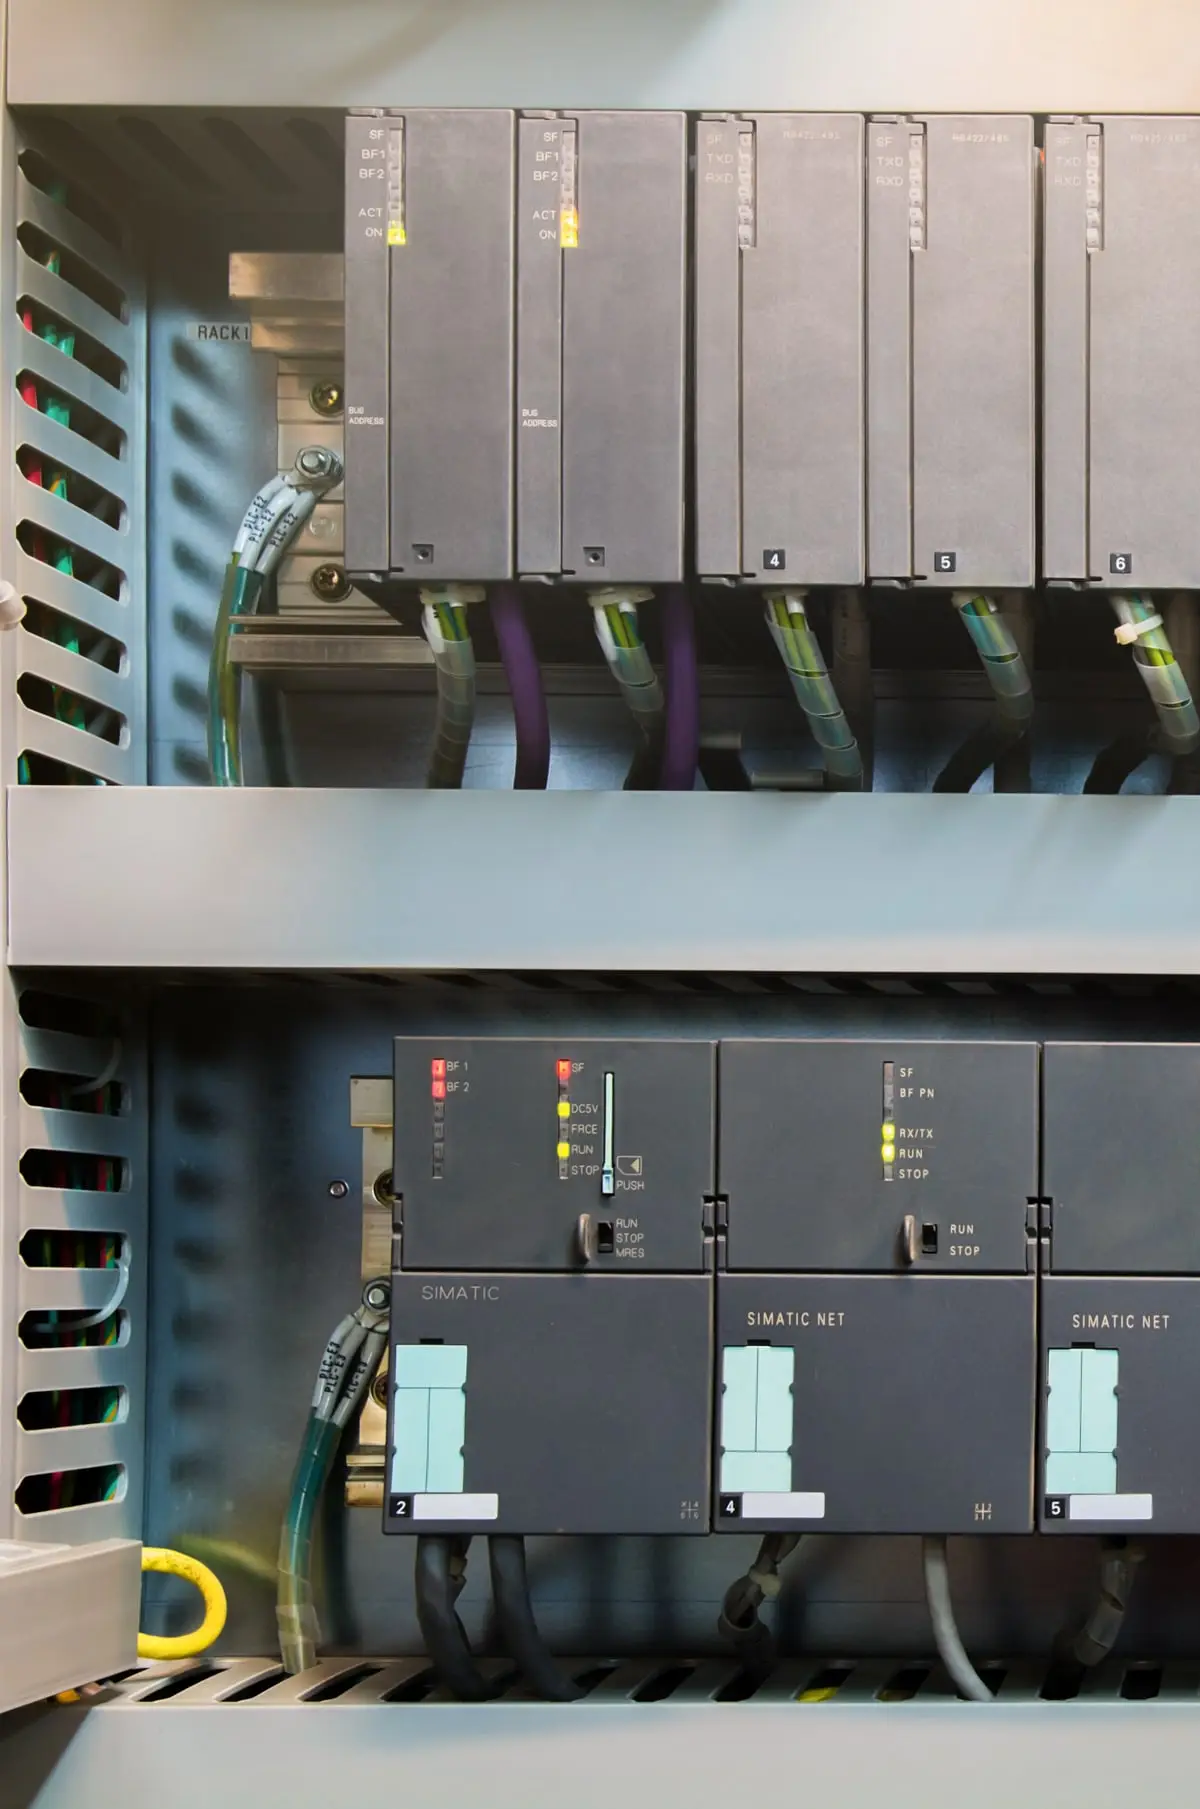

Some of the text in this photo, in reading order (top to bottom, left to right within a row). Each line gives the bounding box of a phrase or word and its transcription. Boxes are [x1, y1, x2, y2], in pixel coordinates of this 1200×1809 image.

[369, 129, 385, 140] SF
[543, 132, 559, 142] SF
[876, 136, 892, 147] SF
[361, 149, 386, 159] BF1
[535, 151, 559, 161] BF1
[706, 153, 734, 164] TXD
[876, 156, 903, 168] TXD
[1055, 156, 1081, 167] TXD
[359, 169, 385, 179] BF2
[533, 171, 558, 181] BF2
[876, 176, 903, 187] RXD
[358, 208, 382, 217] ACT
[532, 210, 556, 220] ACT
[365, 227, 383, 237] ON
[539, 230, 557, 240] ON
[348, 417, 384, 425] ADDRESS
[522, 419, 558, 428] ADDRESS
[769, 553, 780, 567] 4
[939, 555, 952, 570] 5
[1114, 556, 1127, 571] 6
[446, 1061, 468, 1071] BF 1
[571, 1063, 584, 1073] SF
[899, 1067, 913, 1078] SF
[446, 1082, 470, 1092] BF 2
[899, 1088, 934, 1099] BF PN
[571, 1104, 599, 1114] DC5V
[571, 1124, 598, 1134] FRCE
[899, 1128, 934, 1139] RX/TX
[571, 1145, 594, 1155] RUN
[899, 1149, 923, 1159] RUN
[571, 1165, 599, 1175] STOP
[898, 1169, 929, 1179] STOP
[616, 1181, 645, 1190] PUSH
[616, 1219, 638, 1228] RUN
[950, 1225, 974, 1235] RUN
[616, 1233, 644, 1243] STOP
[616, 1248, 645, 1258] MRES
[949, 1246, 980, 1256] STOP
[421, 1285, 500, 1301] SIMATIC
[747, 1311, 845, 1326] SIMATIC NET
[1072, 1314, 1170, 1329] SIMATIC NET
[395, 1500, 407, 1515] 2
[725, 1500, 736, 1514] 4
[1051, 1501, 1060, 1515] 5
